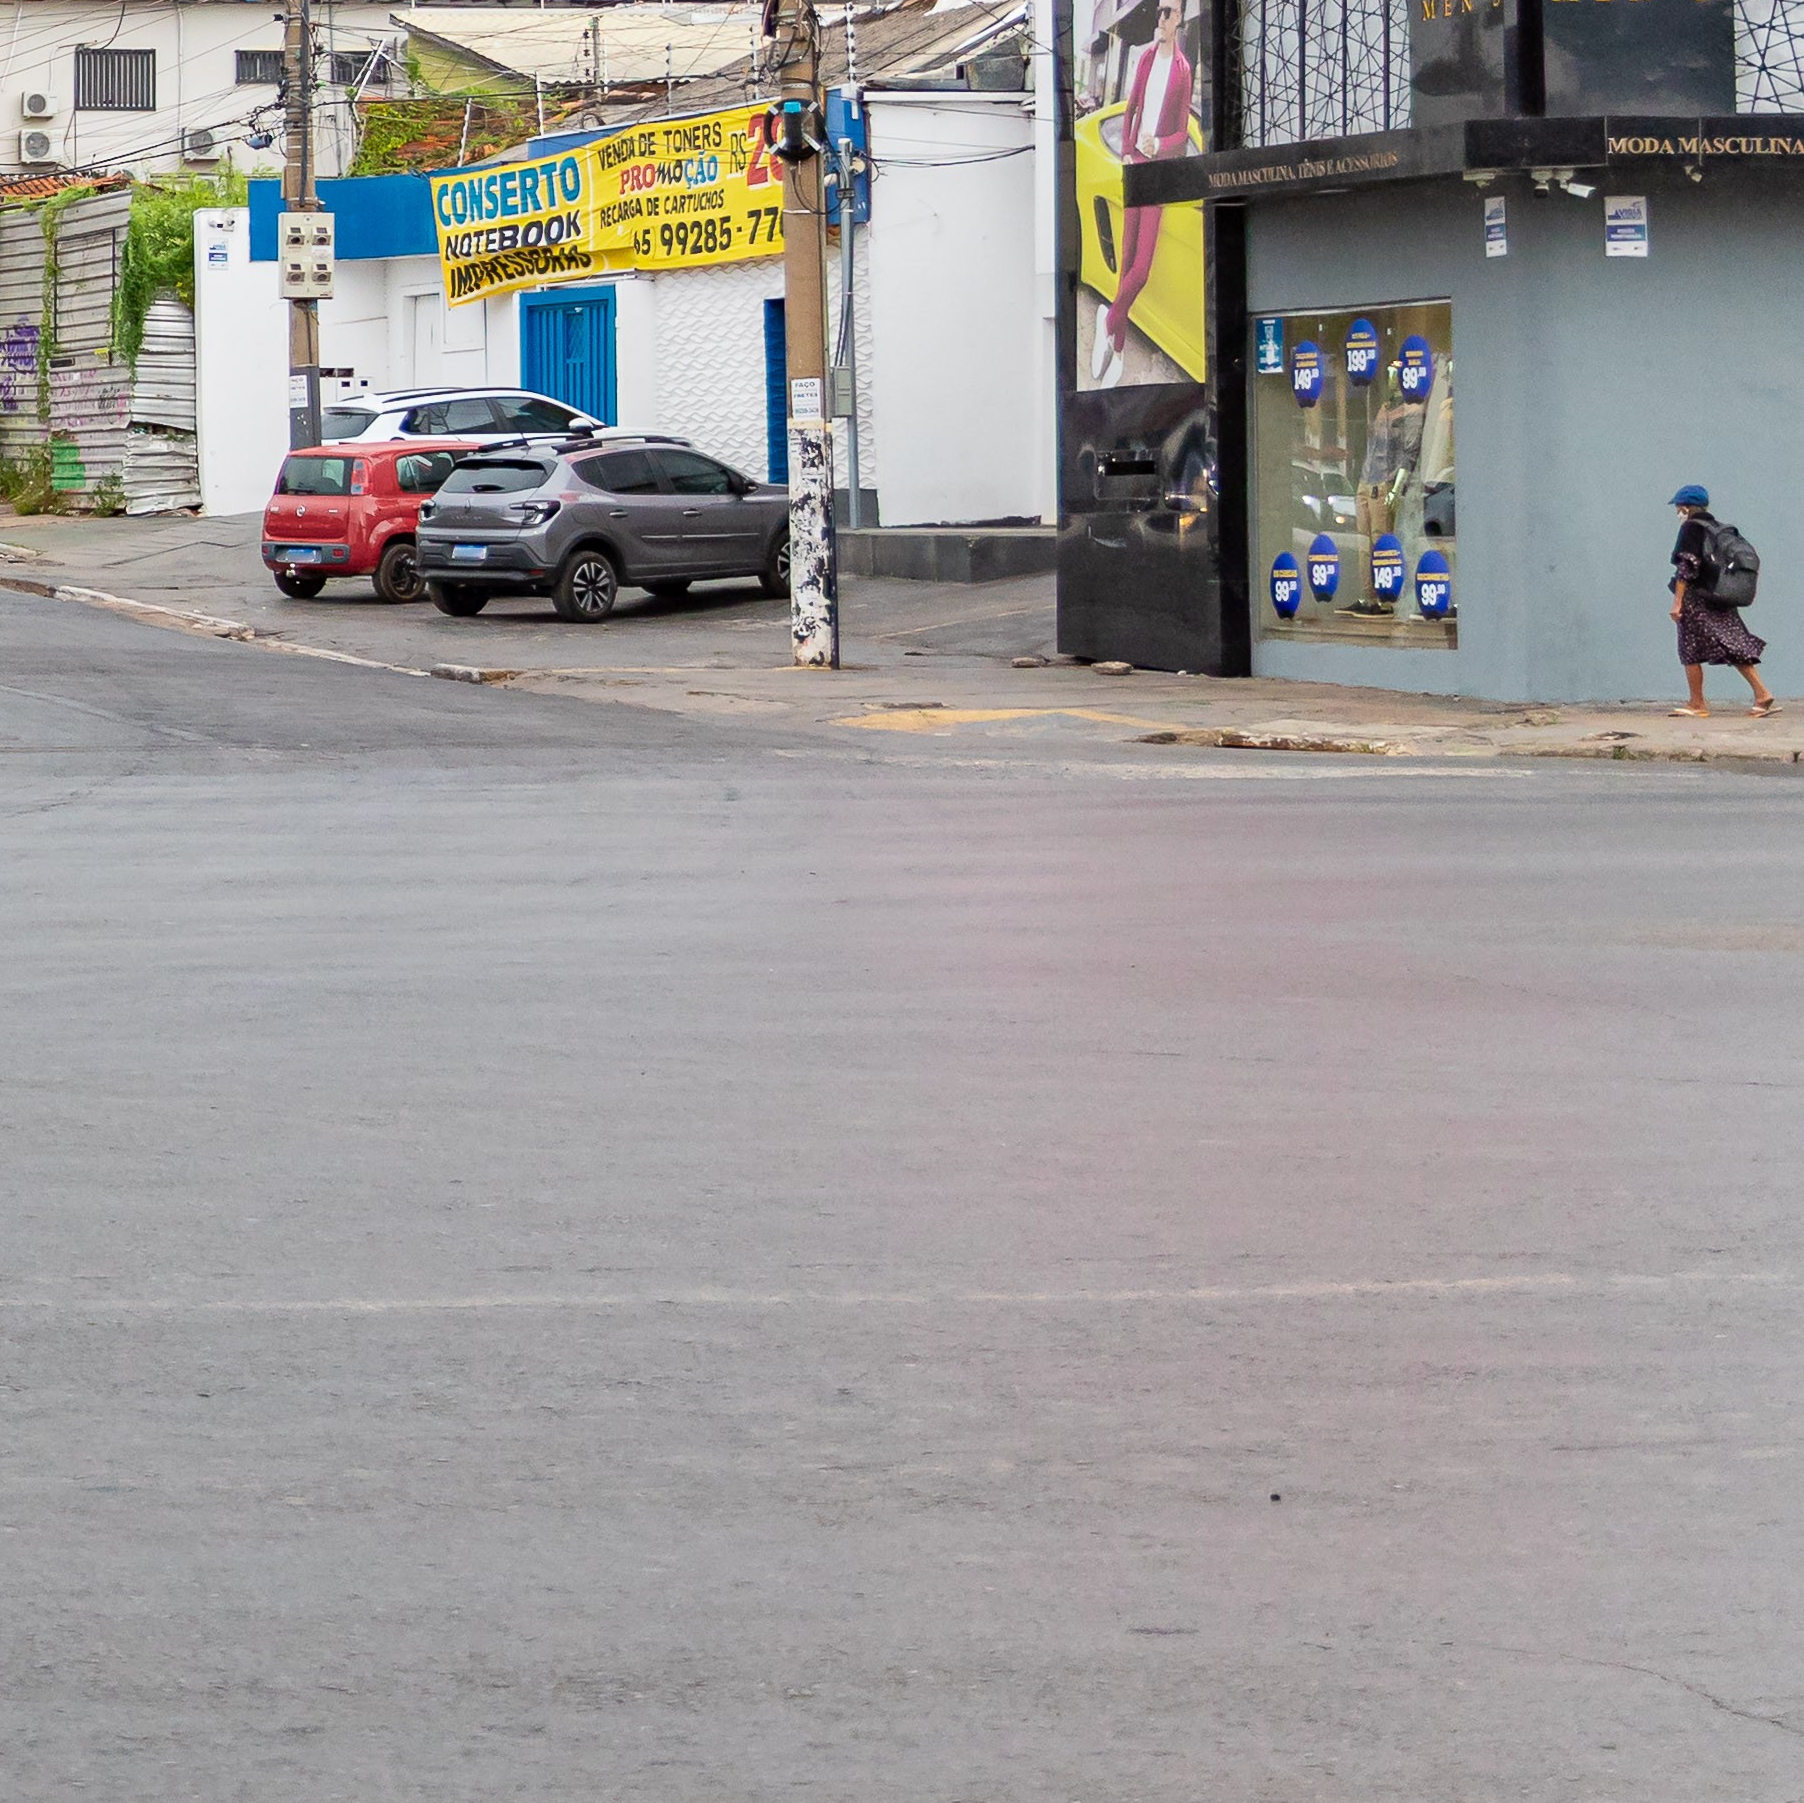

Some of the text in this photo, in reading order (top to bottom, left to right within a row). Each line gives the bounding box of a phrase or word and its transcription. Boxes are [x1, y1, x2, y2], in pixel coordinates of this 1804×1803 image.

[598, 121, 722, 171] VENDA DE TONERS
[1607, 137, 1804, 154] MODA MASCULINA
[436, 155, 581, 227] CONSERTO
[619, 150, 718, 195] PROMOÇÃO
[1208, 173, 1238, 189] MODA
[600, 188, 725, 229] RECARGA DE CARTUCHOS
[445, 209, 582, 261] NOTEBOOK
[449, 244, 593, 299] IMPRESSORAS
